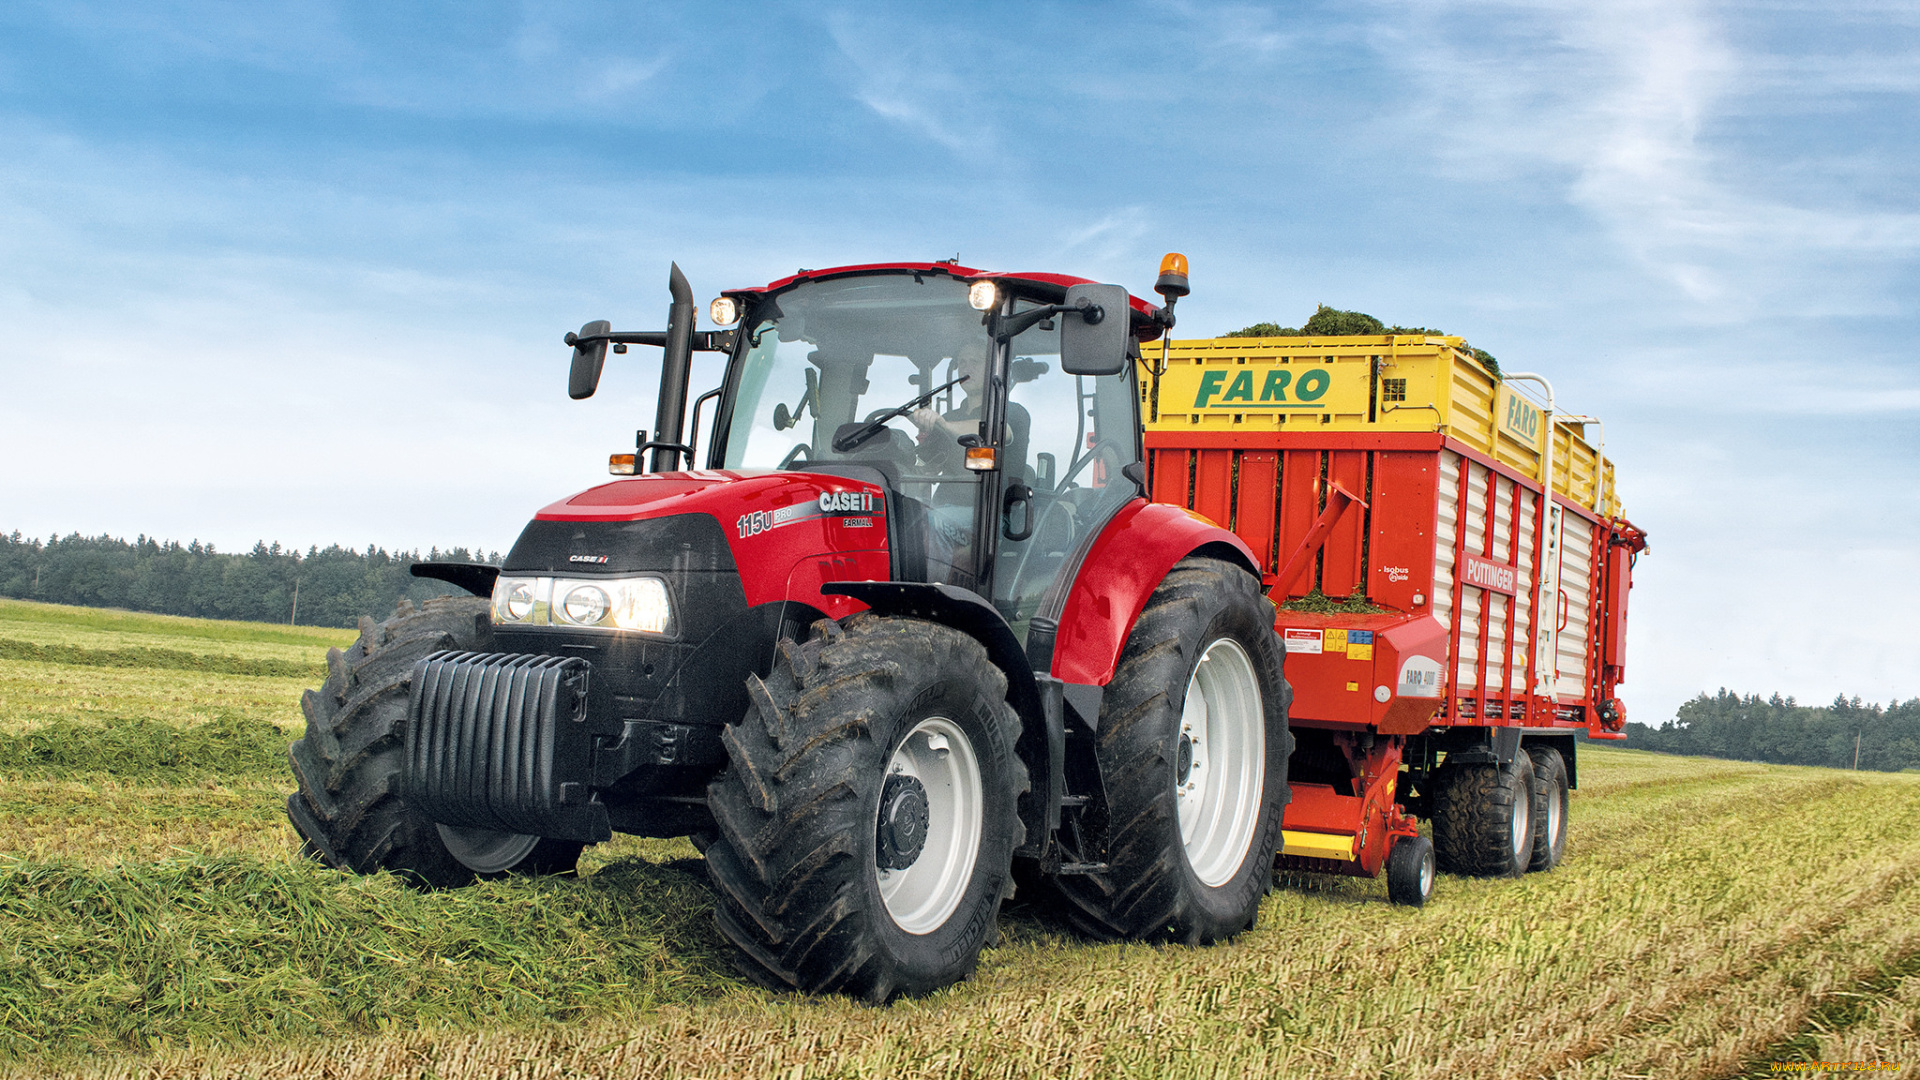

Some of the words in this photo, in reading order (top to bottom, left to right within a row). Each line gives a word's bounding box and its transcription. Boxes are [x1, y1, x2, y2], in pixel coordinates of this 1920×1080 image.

[1193, 369, 1331, 408] FARO
[1507, 394, 1537, 438] FARO
[737, 510, 773, 539] 115U
[774, 508, 792, 521] PRO
[843, 518, 873, 528] FARMALL
[1383, 565, 1409, 574] Isobus
[1406, 669, 1422, 685] FARO
